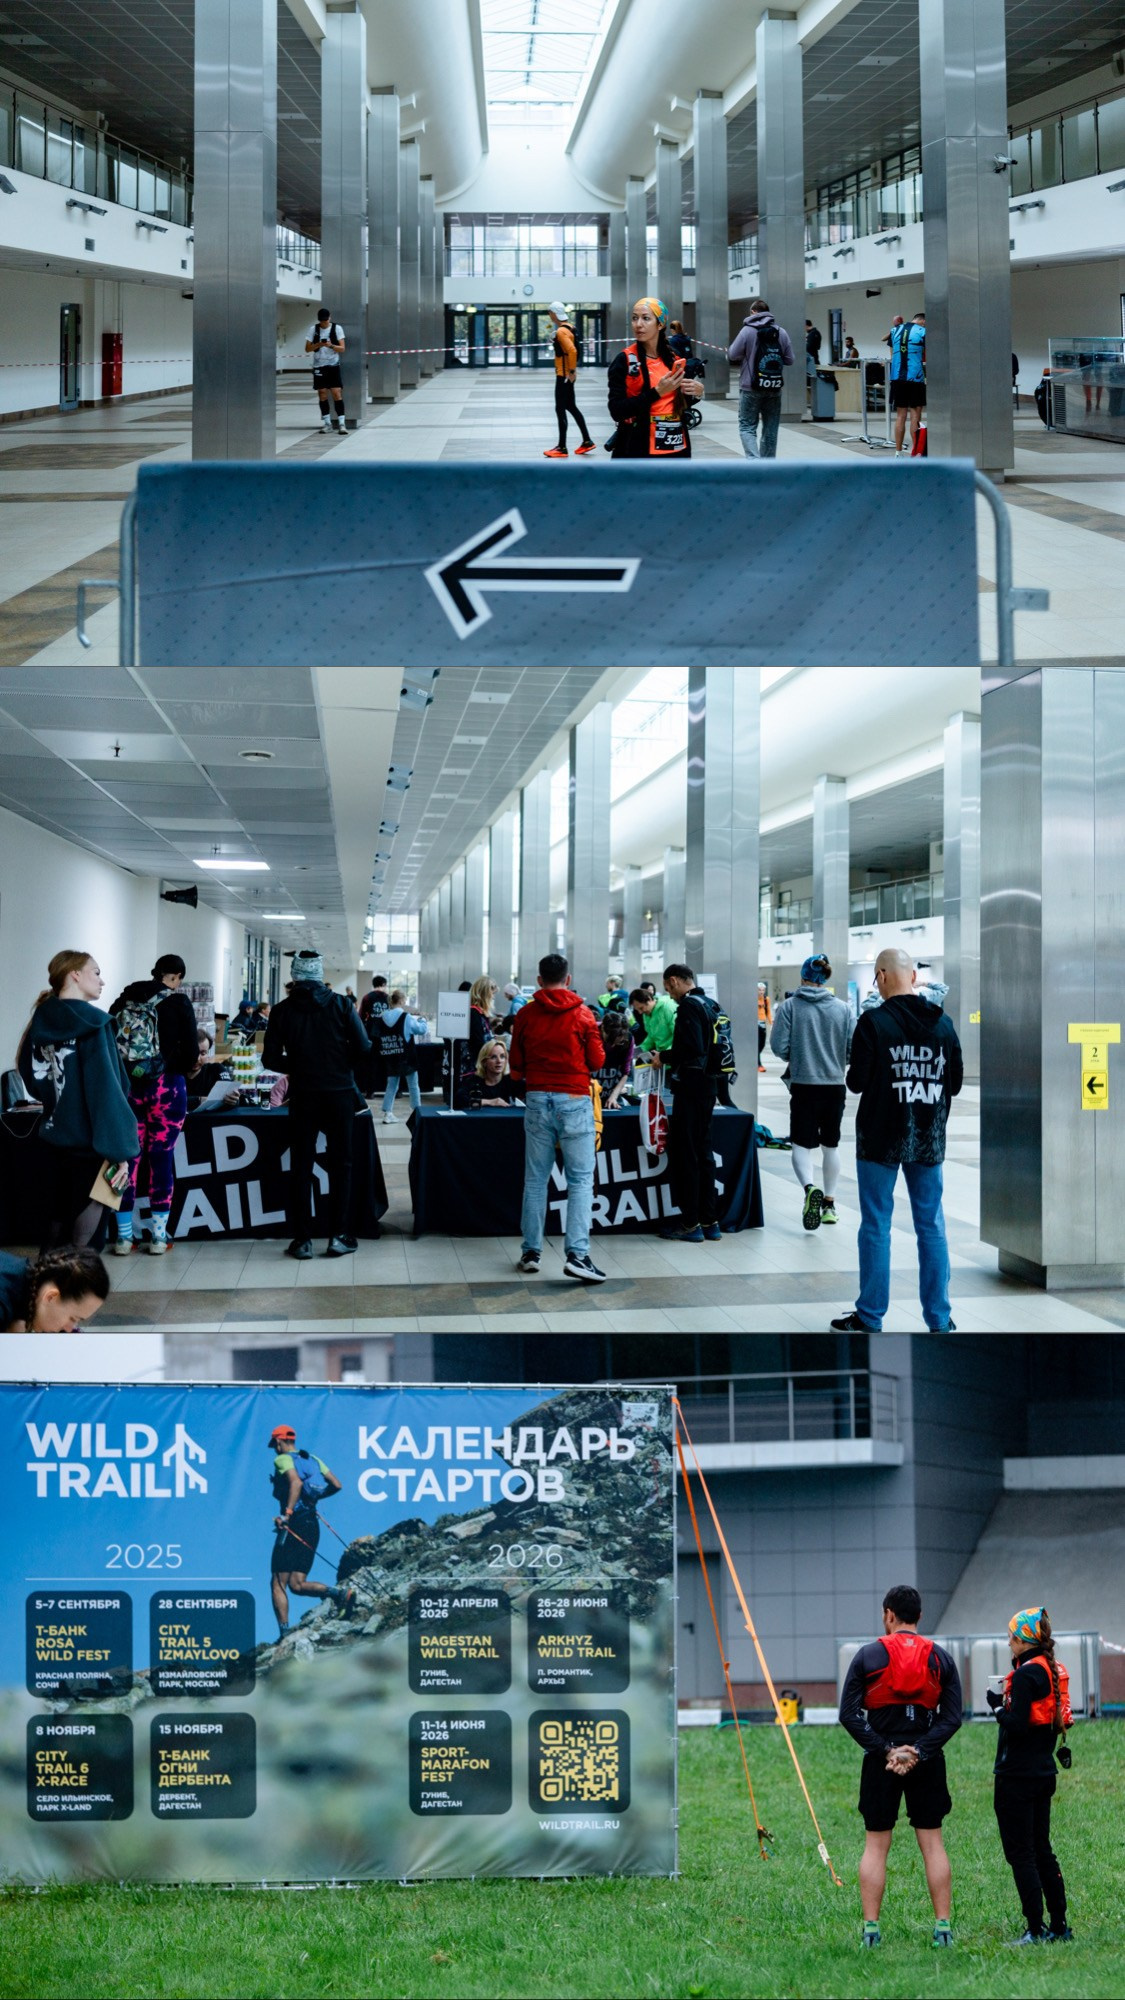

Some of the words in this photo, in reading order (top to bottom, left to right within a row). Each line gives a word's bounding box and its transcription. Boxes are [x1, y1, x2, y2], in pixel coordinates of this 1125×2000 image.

[758, 378, 782, 388] 1012
[889, 1045, 933, 1062] WILD
[1092, 1047, 1098, 1058] 2
[892, 1080, 943, 1104] TEAM
[174, 1124, 259, 1179] LD
[26, 1422, 159, 1458] WILD
[358, 1426, 636, 1466] КАЛЕНДАРЬ
[26, 1462, 172, 1498] TRAIL
[358, 1468, 565, 1502] СТАРТОВ
[105, 1544, 182, 1569] 2025
[488, 1544, 564, 1568] 2026
[58, 1600, 120, 1609] СЕНТЯБРЯ
[158, 1599, 173, 1609] 28
[176, 1599, 238, 1609] СЕНТЯБРЯ
[452, 1598, 498, 1608] АПРЕЛЯ
[573, 1598, 608, 1608] ИЮНЯ
[420, 1609, 449, 1619] 2026
[537, 1609, 566, 1618] 2026
[36, 1626, 87, 1636] Т-БАНК
[159, 1625, 190, 1636] CITY
[36, 1638, 75, 1648] ROSA
[159, 1637, 199, 1648] TRAIL
[203, 1637, 211, 1648] 5
[420, 1635, 492, 1647] DAGESTAN
[538, 1635, 593, 1646] ARKHYZ
[36, 1650, 73, 1661] WILD
[78, 1650, 111, 1660] FEST
[159, 1649, 240, 1660] IZMAYLOVO
[420, 1648, 457, 1659] WILD
[460, 1647, 500, 1658] TRAIL
[538, 1647, 574, 1658] WILD
[577, 1647, 616, 1658] TRAIL
[36, 1672, 74, 1680] КРАСНАЯ
[76, 1672, 113, 1680] ПОЛЯНА,
[159, 1670, 227, 1679] ИЗМАЙЛОВСКИЙ
[420, 1670, 450, 1678] ГУНИБ,
[547, 1669, 593, 1677] РОМАНТИК,
[36, 1681, 59, 1689] СОЧИ
[159, 1681, 183, 1689] ПАРК,
[420, 1678, 462, 1687] ДАГЕСТАН
[538, 1678, 566, 1686] АРХЫЗ
[36, 1726, 43, 1735] 8
[47, 1726, 96, 1735] НОЯБРЯ
[159, 1724, 171, 1734] 15
[174, 1724, 223, 1734] НОЯБРЯ
[450, 1720, 486, 1730] ИЮНЯ
[420, 1731, 450, 1741] 2026
[36, 1751, 68, 1762] CITY
[159, 1750, 210, 1761] Т-БАНК
[421, 1747, 470, 1758] SPORT-
[36, 1763, 76, 1774] TRAIL
[80, 1763, 89, 1774] 6
[159, 1763, 197, 1774] ОГНИ
[421, 1759, 490, 1770] MARAFON
[36, 1775, 88, 1787] X-RACE
[159, 1775, 231, 1787] ДЕРБЕНТА
[422, 1771, 454, 1783] FEST
[61, 1794, 114, 1803] ИЛЬИНСКОЕ,
[159, 1794, 197, 1802] ДЕРБЕНТ,
[420, 1791, 450, 1800] ГУНИБ,
[159, 1803, 202, 1811] ДАГЕСТАН
[420, 1800, 463, 1809] ДАГЕСТАН
[539, 1820, 620, 1831] WILDTRAIL.RU
